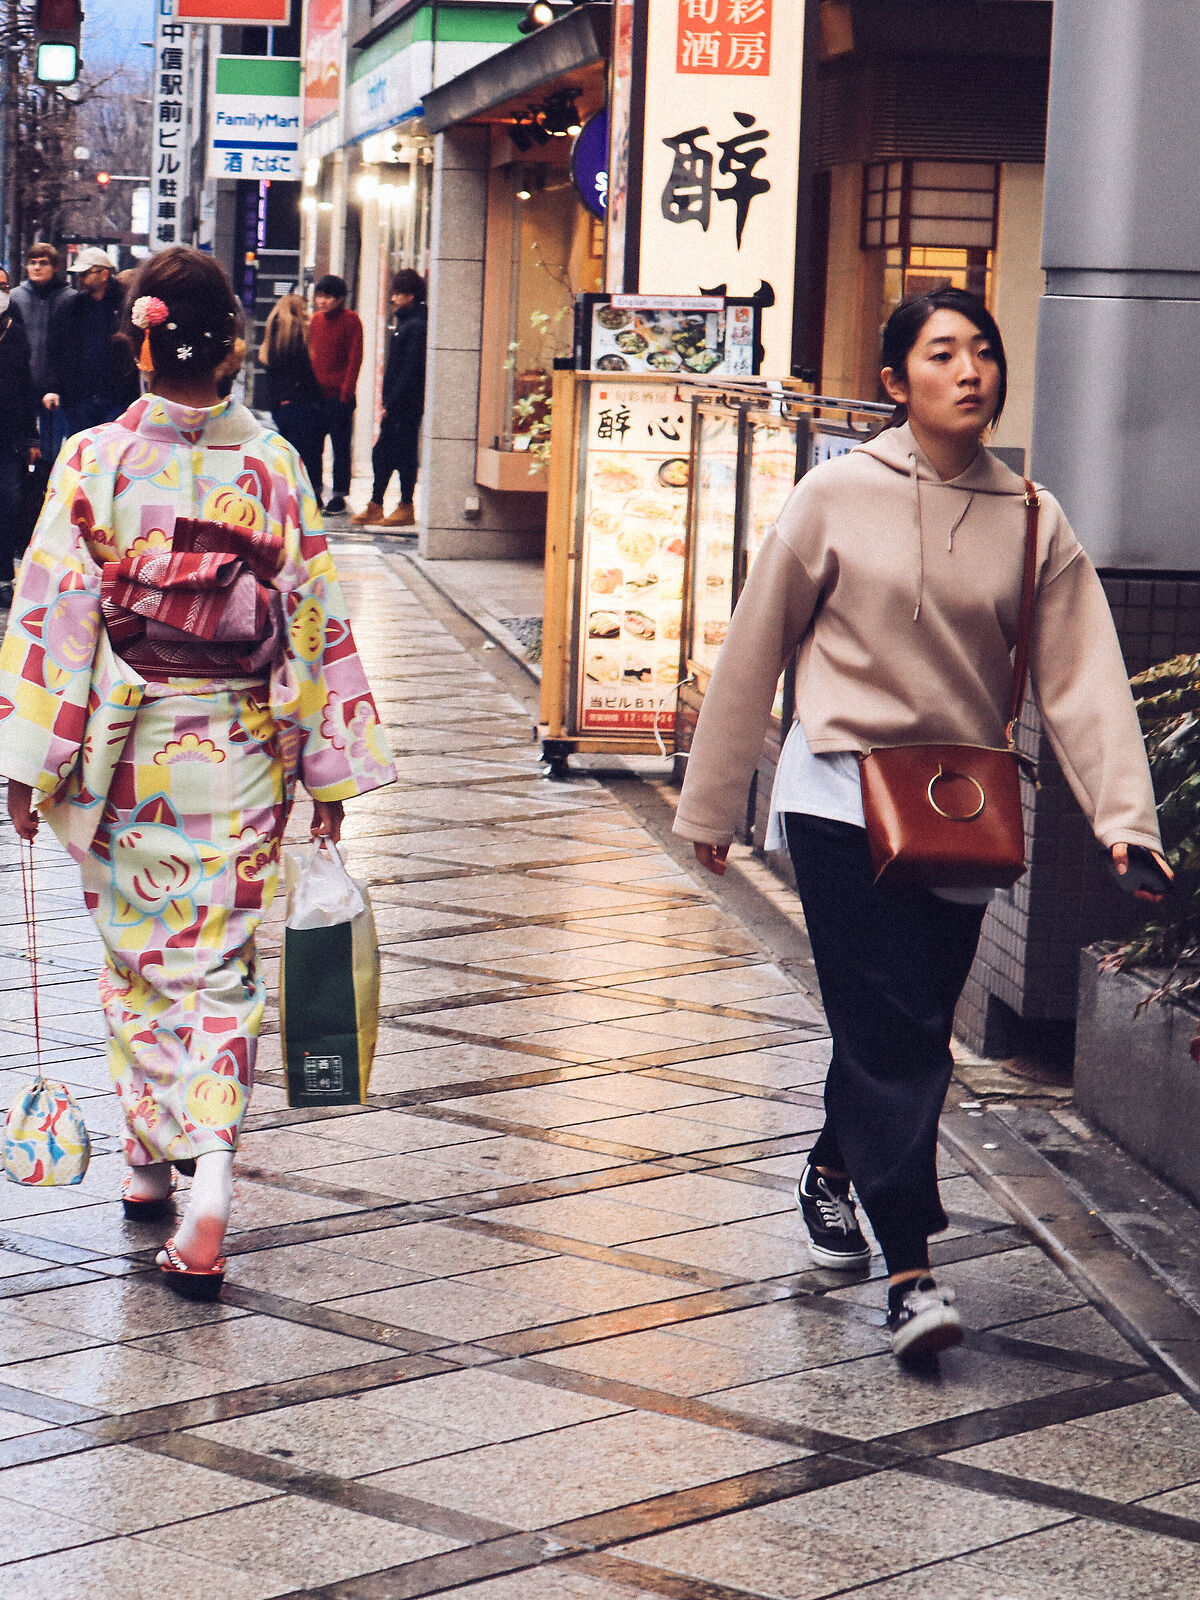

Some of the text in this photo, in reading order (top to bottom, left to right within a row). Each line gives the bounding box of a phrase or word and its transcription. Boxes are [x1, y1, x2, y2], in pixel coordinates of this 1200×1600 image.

[216, 111, 299, 131] FamilyMart
[157, 24, 185, 243] 中信駅前ビル駐車場
[224, 152, 291, 173] 酒 たばこ
